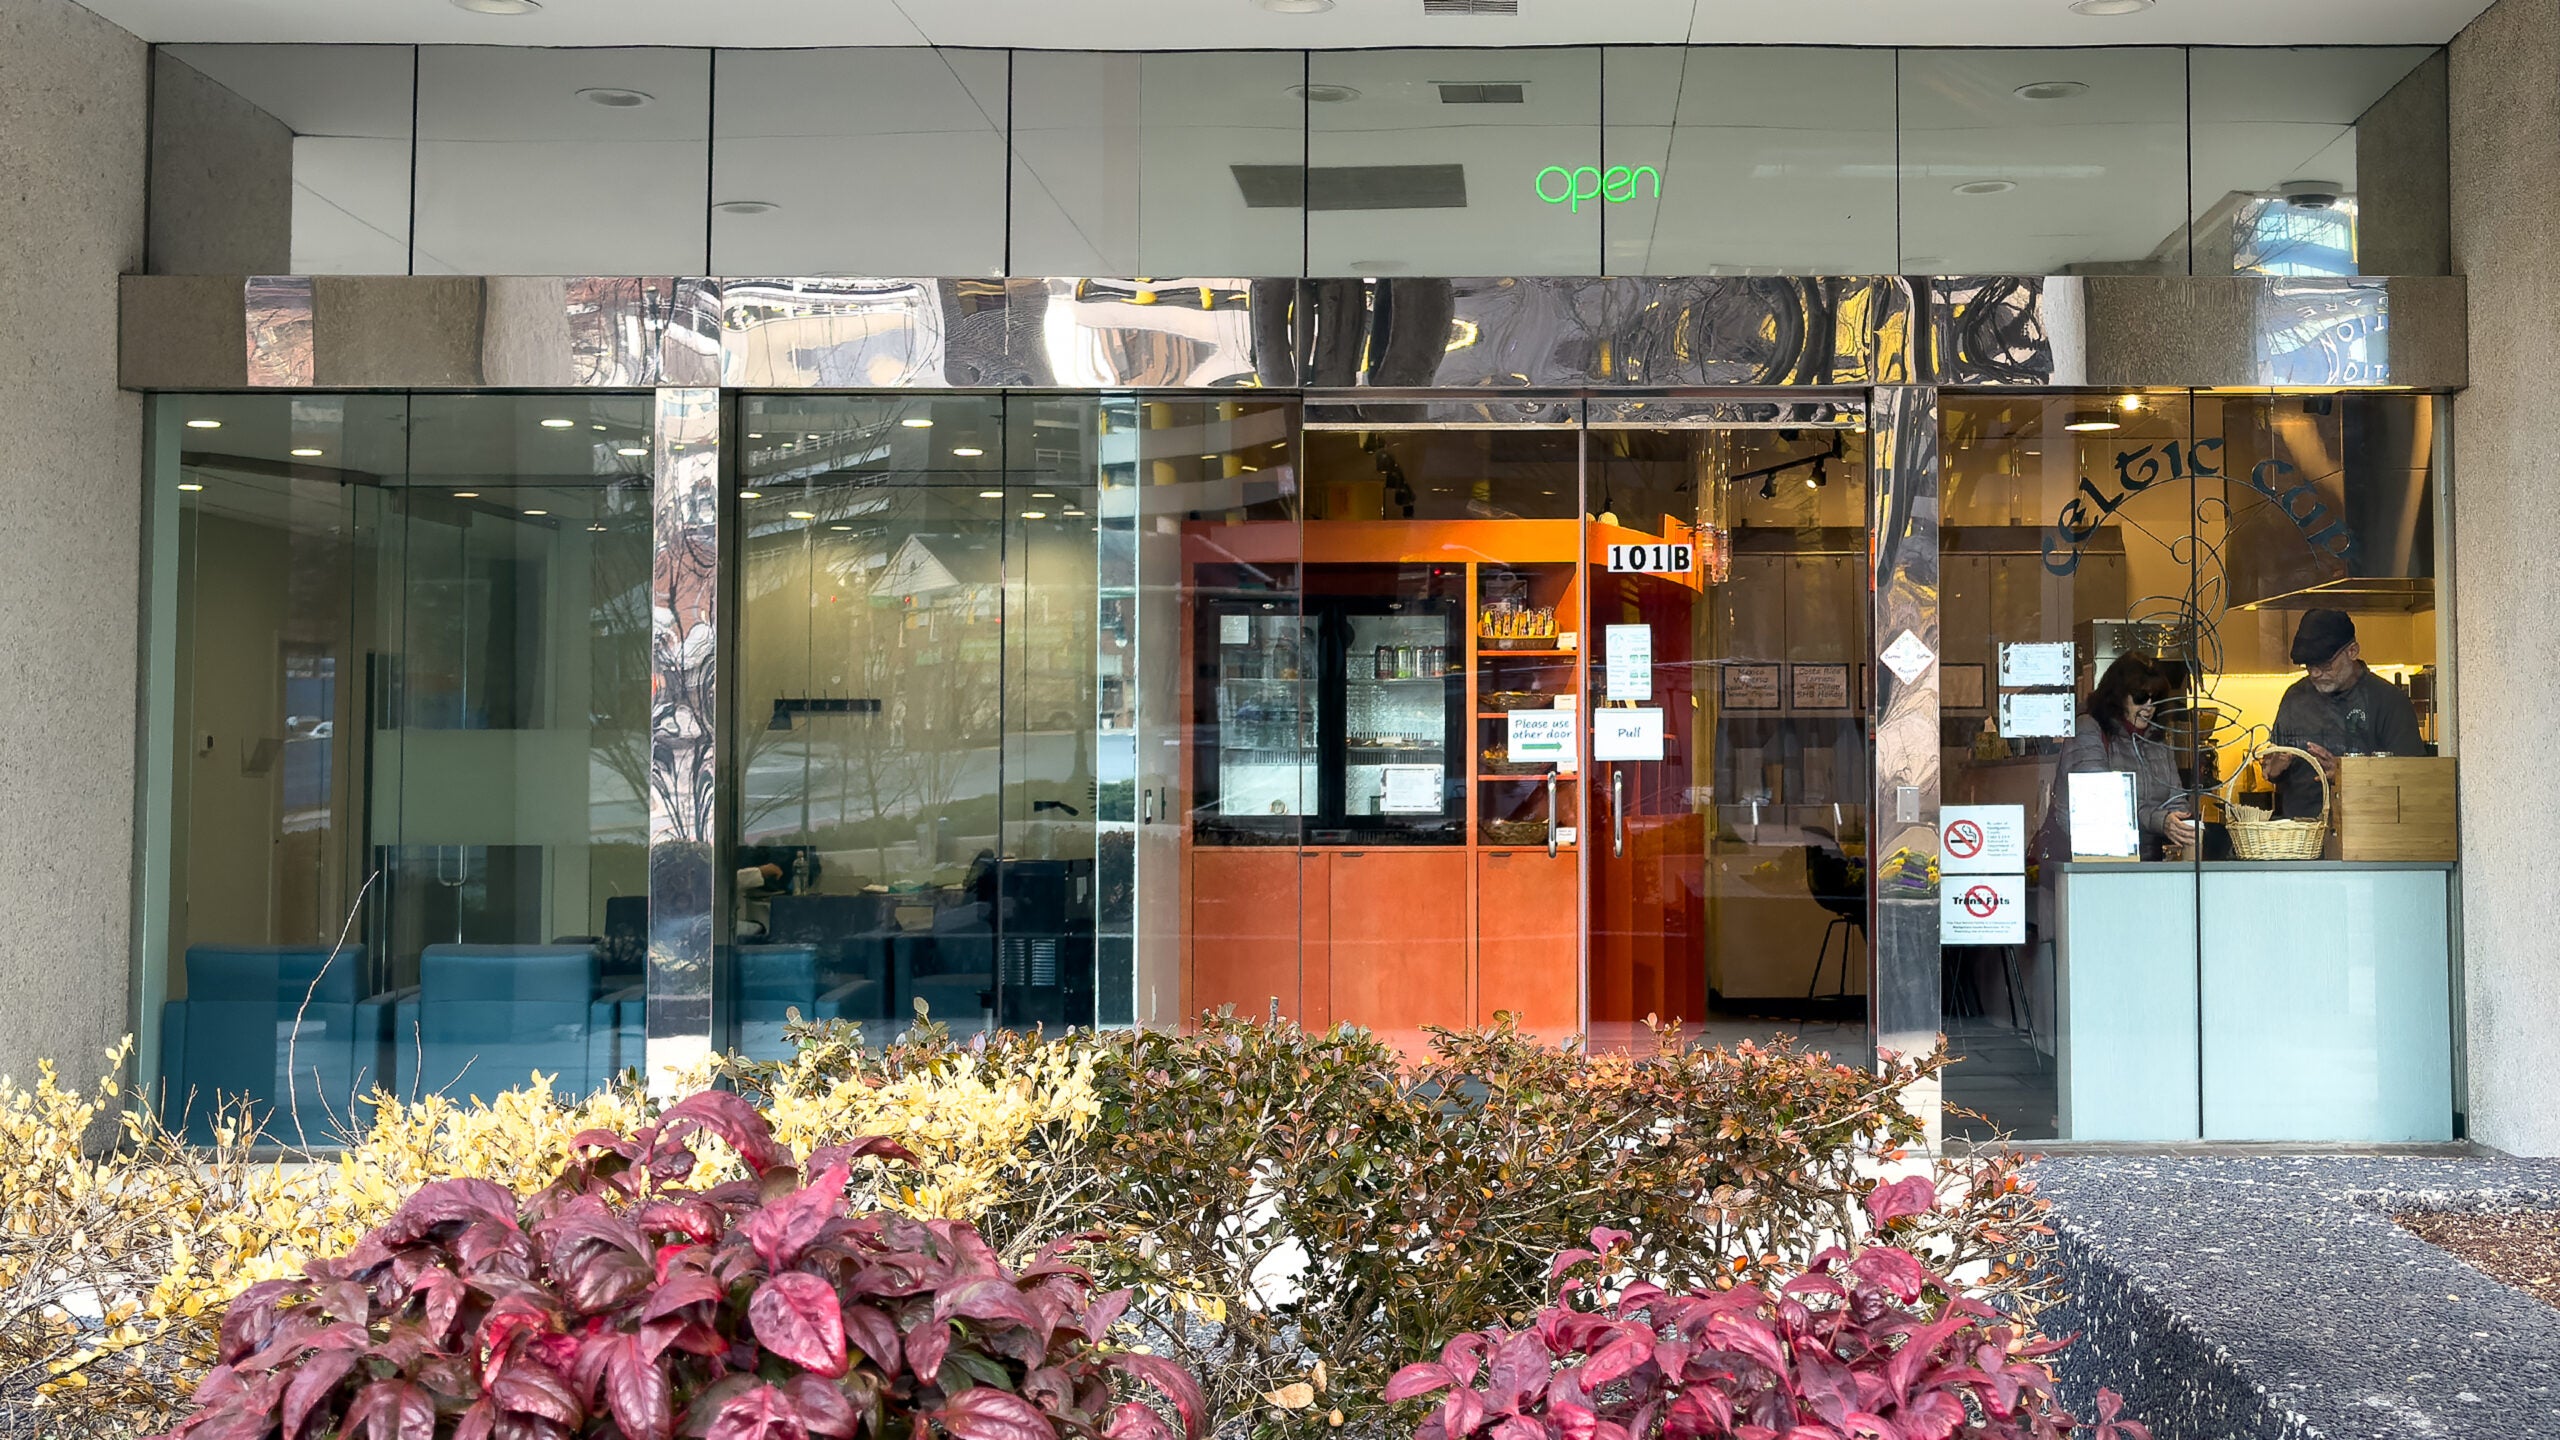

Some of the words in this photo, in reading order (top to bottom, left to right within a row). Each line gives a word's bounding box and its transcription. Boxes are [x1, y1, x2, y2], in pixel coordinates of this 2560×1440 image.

[1535, 165, 1661, 213] open
[1514, 719, 1549, 729] Please
[1552, 719, 1570, 728] use
[1512, 729, 1543, 739] other
[1546, 729, 1573, 739] door
[1617, 726, 1641, 738] Pull
